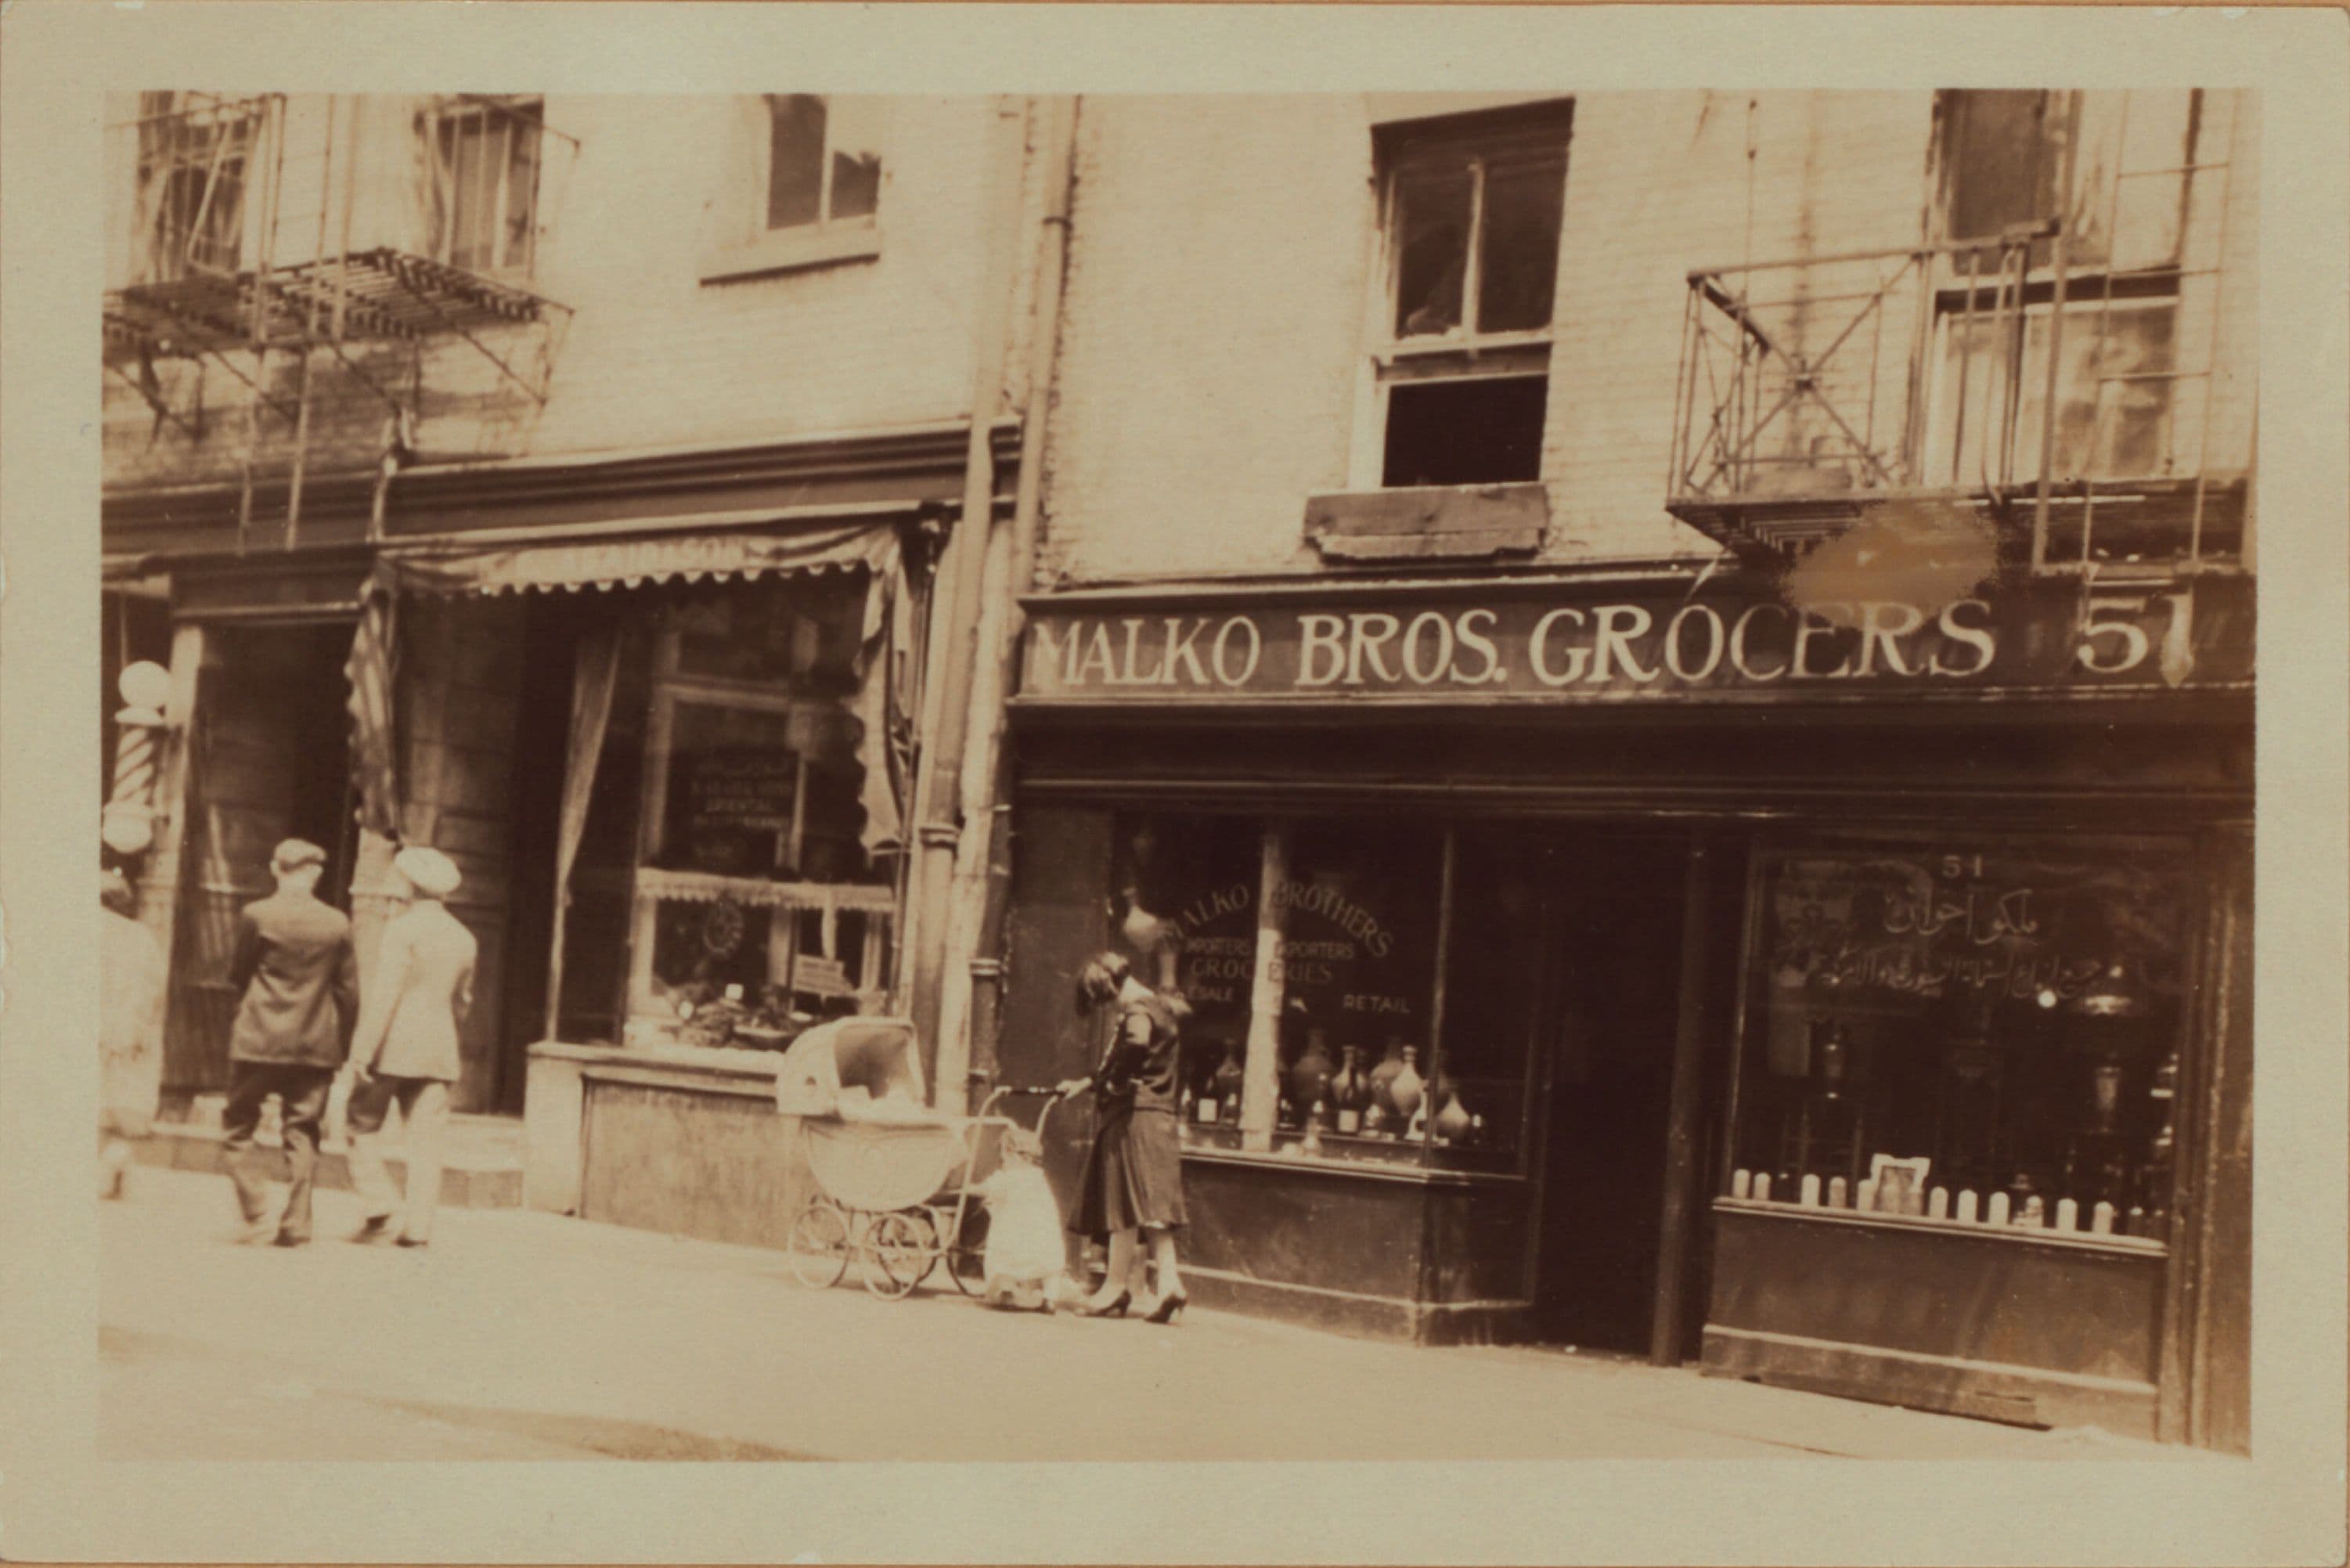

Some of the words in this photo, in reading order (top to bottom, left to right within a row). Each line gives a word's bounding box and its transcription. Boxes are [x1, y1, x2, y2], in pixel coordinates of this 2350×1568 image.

[1032, 616, 1260, 687] MALKO
[1295, 609, 1508, 686] BROS.
[1529, 600, 1995, 686] GROCERS
[2077, 593, 2195, 679] 51
[1942, 854, 1982, 879] 51
[1271, 880, 1395, 958] BROTHERS
[1343, 992, 1411, 1014] RETAIL
